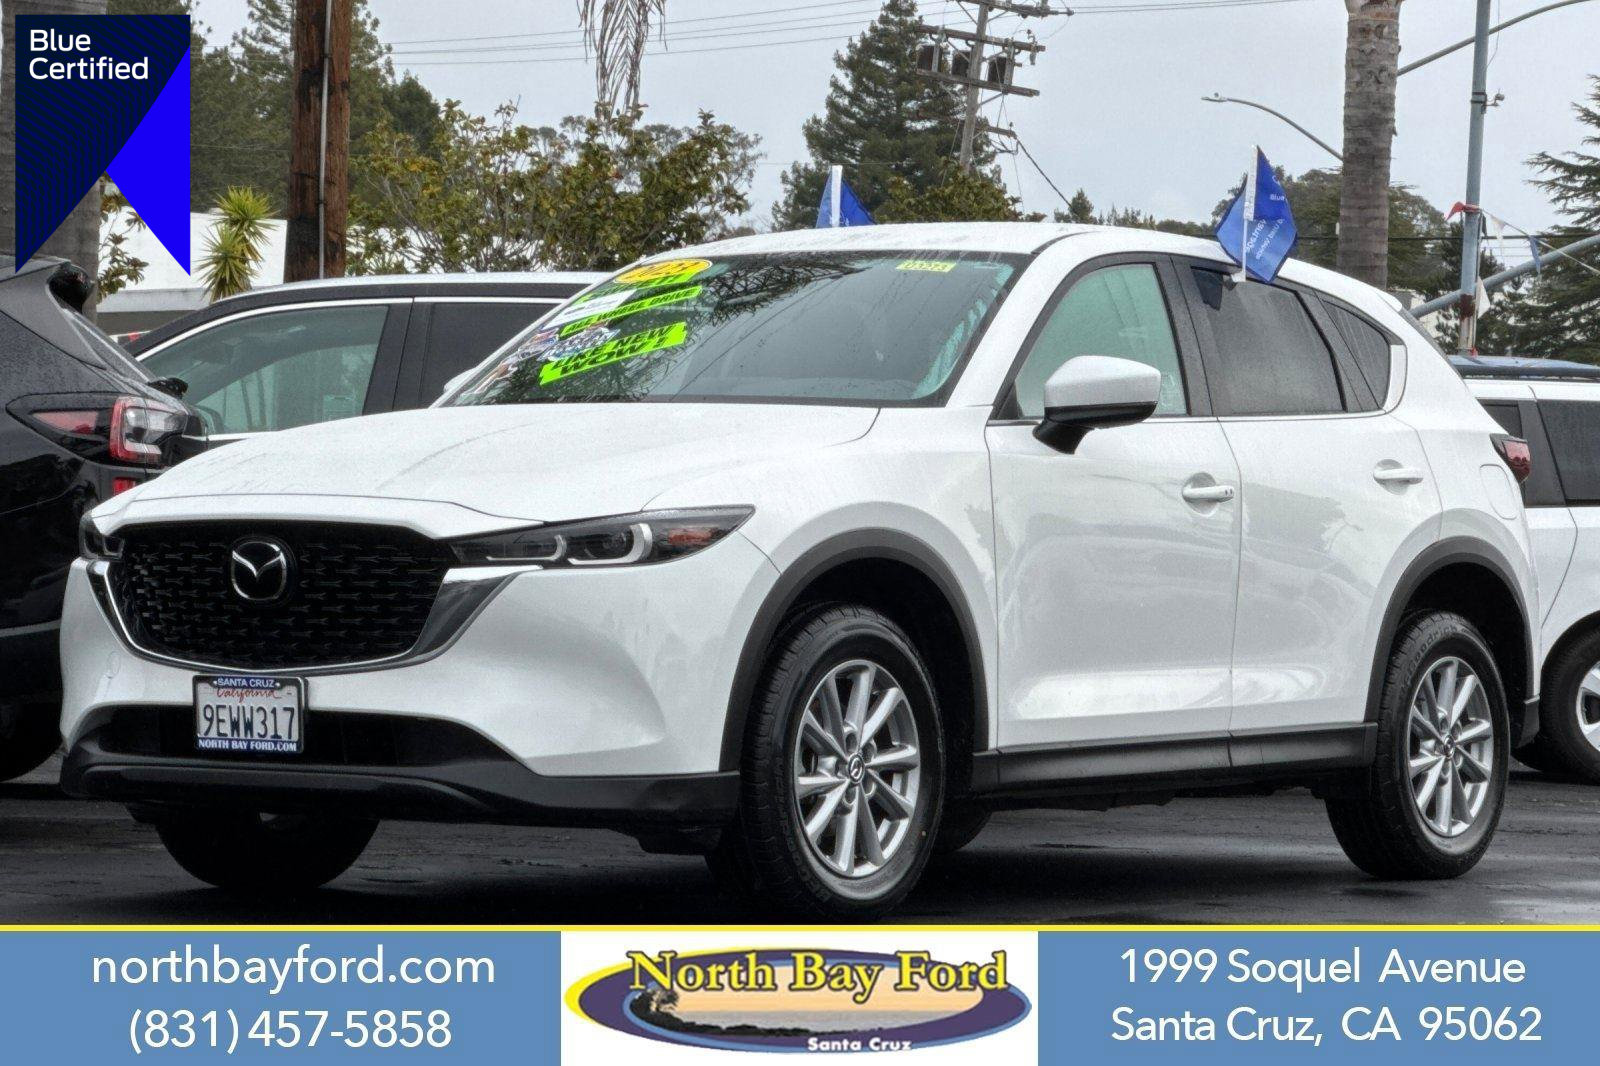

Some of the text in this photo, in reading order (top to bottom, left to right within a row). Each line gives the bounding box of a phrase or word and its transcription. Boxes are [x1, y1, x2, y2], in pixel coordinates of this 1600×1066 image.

[614, 325, 677, 348] NEW
[217, 677, 275, 688] SANTA CRUZ
[216, 687, 281, 703] California
[203, 704, 295, 739] 9EWW317
[198, 739, 297, 752] NORTH BAY FORD.COM
